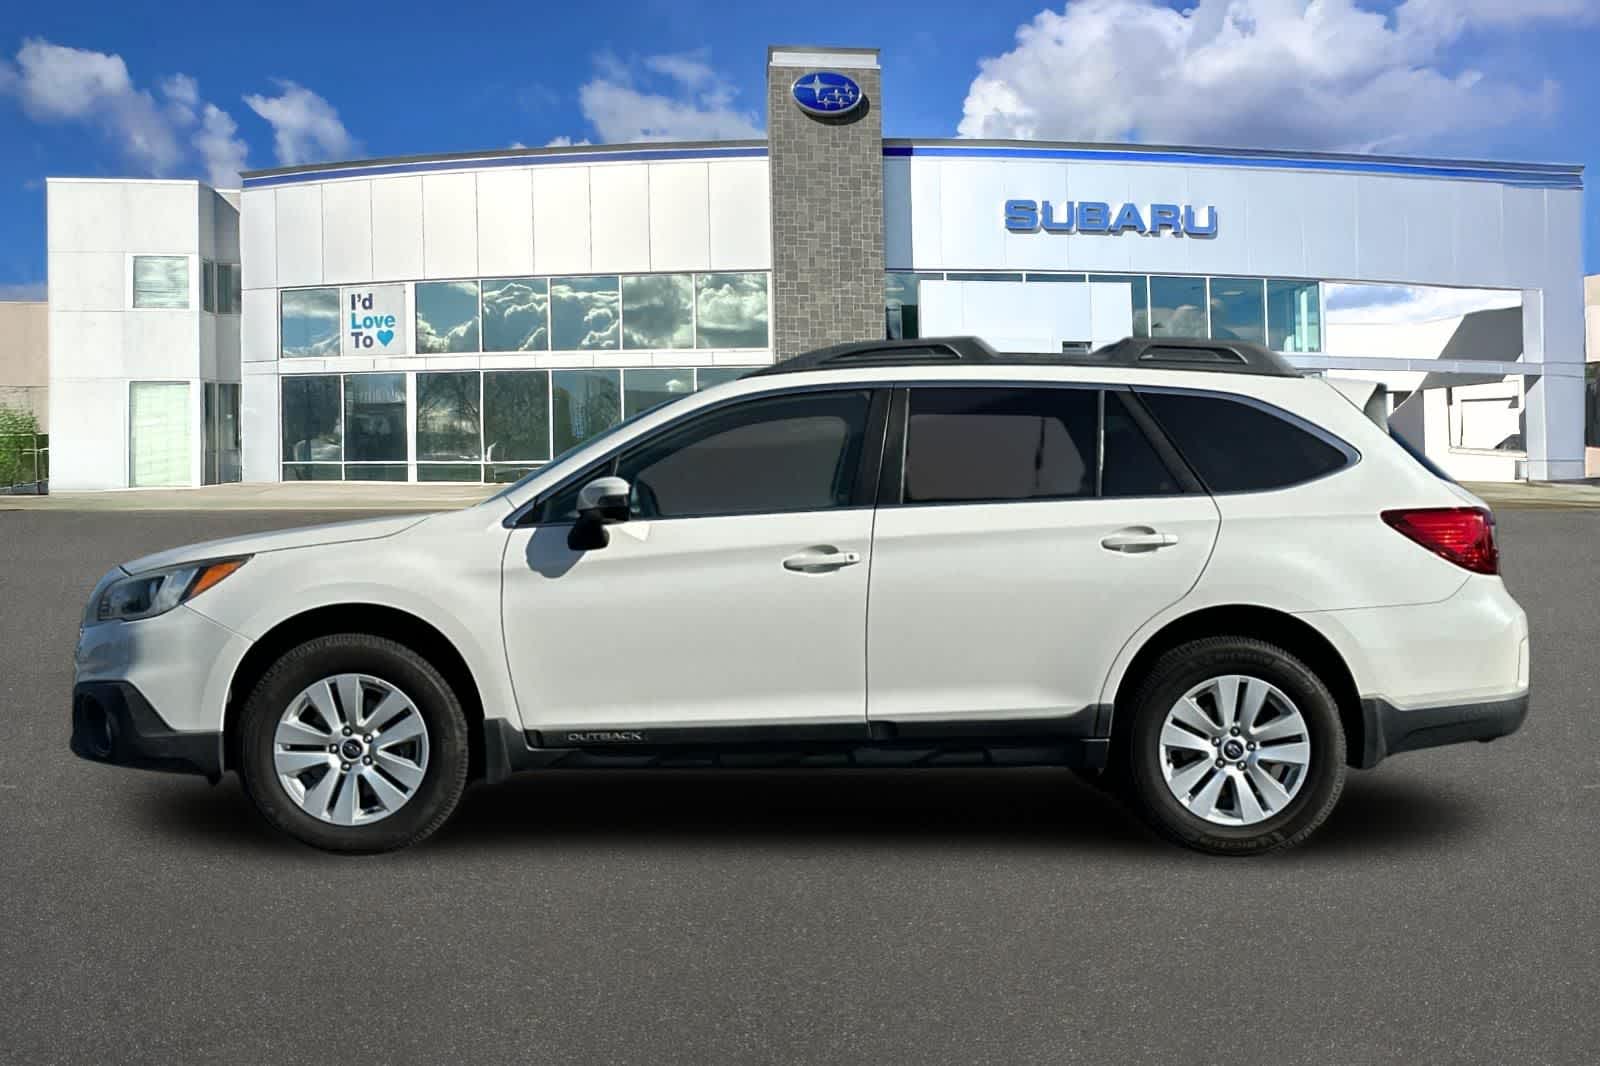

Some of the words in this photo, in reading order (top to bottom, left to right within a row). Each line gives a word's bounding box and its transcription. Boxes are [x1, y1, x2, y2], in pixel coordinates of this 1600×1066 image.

[1005, 199, 1217, 238] SUBARU
[351, 293, 373, 310] I'd
[351, 313, 396, 329] Love
[351, 332, 374, 348] To
[567, 731, 643, 741] OUTBACK
